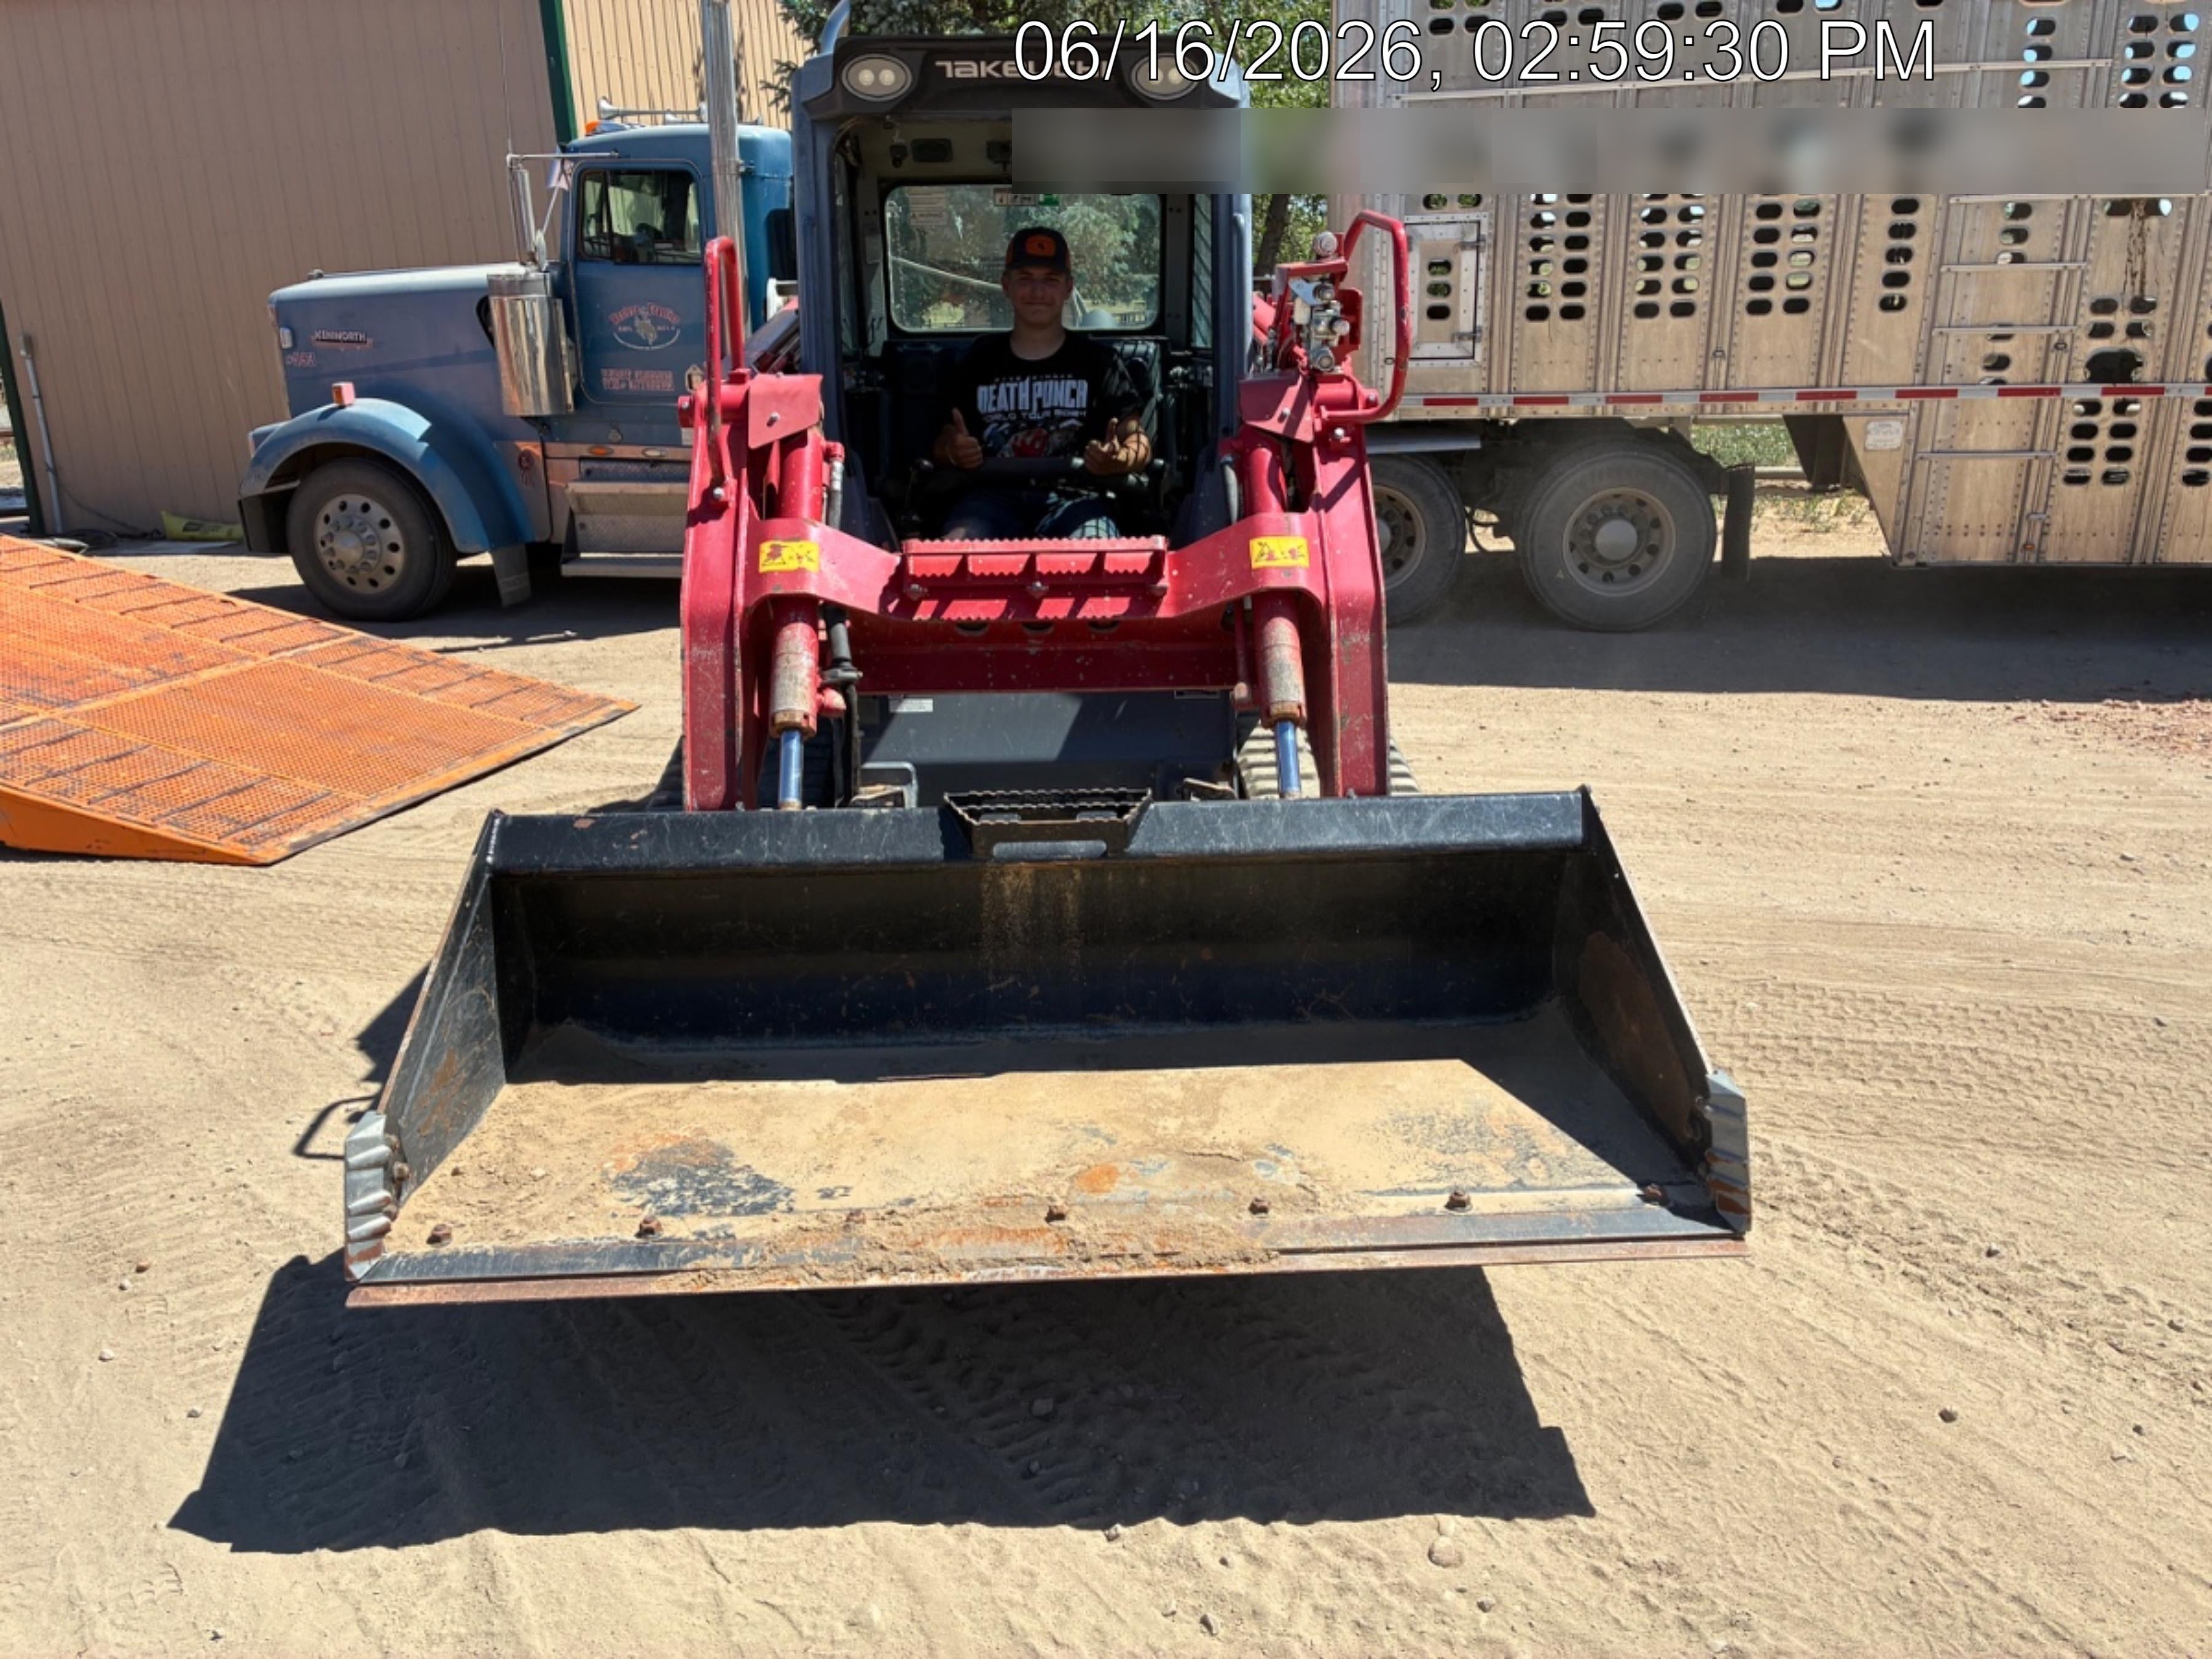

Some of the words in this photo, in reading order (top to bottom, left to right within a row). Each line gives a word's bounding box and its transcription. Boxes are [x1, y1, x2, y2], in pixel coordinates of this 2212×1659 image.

[314, 329, 366, 341] KENWORTH
[977, 377, 1029, 414] DEATH
[1032, 379, 1088, 415] PUNCH
